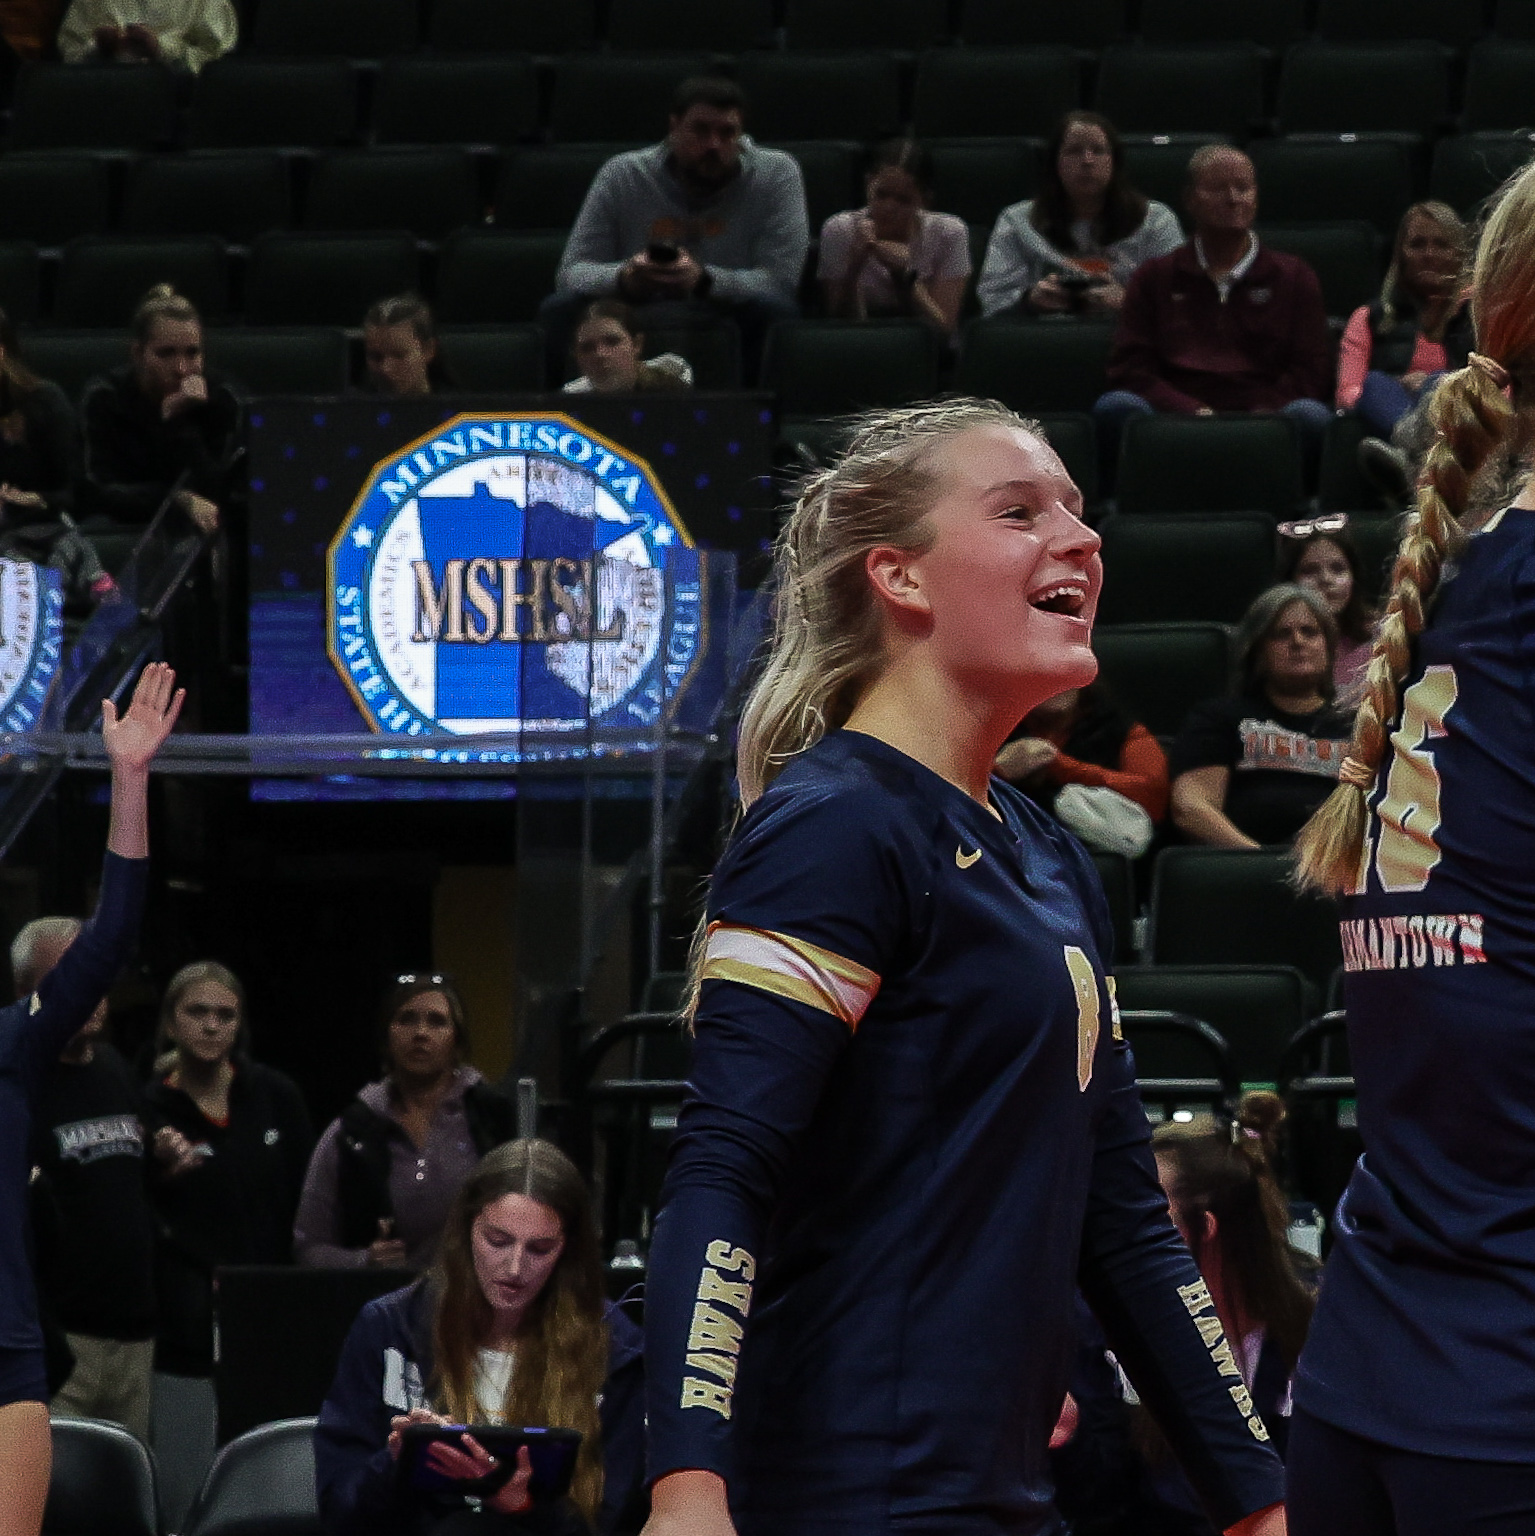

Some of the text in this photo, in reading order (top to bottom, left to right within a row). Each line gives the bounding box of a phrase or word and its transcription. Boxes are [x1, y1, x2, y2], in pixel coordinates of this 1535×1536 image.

[380, 422, 642, 503] MINNESOTA
[336, 584, 387, 703] STATE
[411, 558, 627, 643] MSHSL
[680, 1239, 757, 1421] HAWKS
